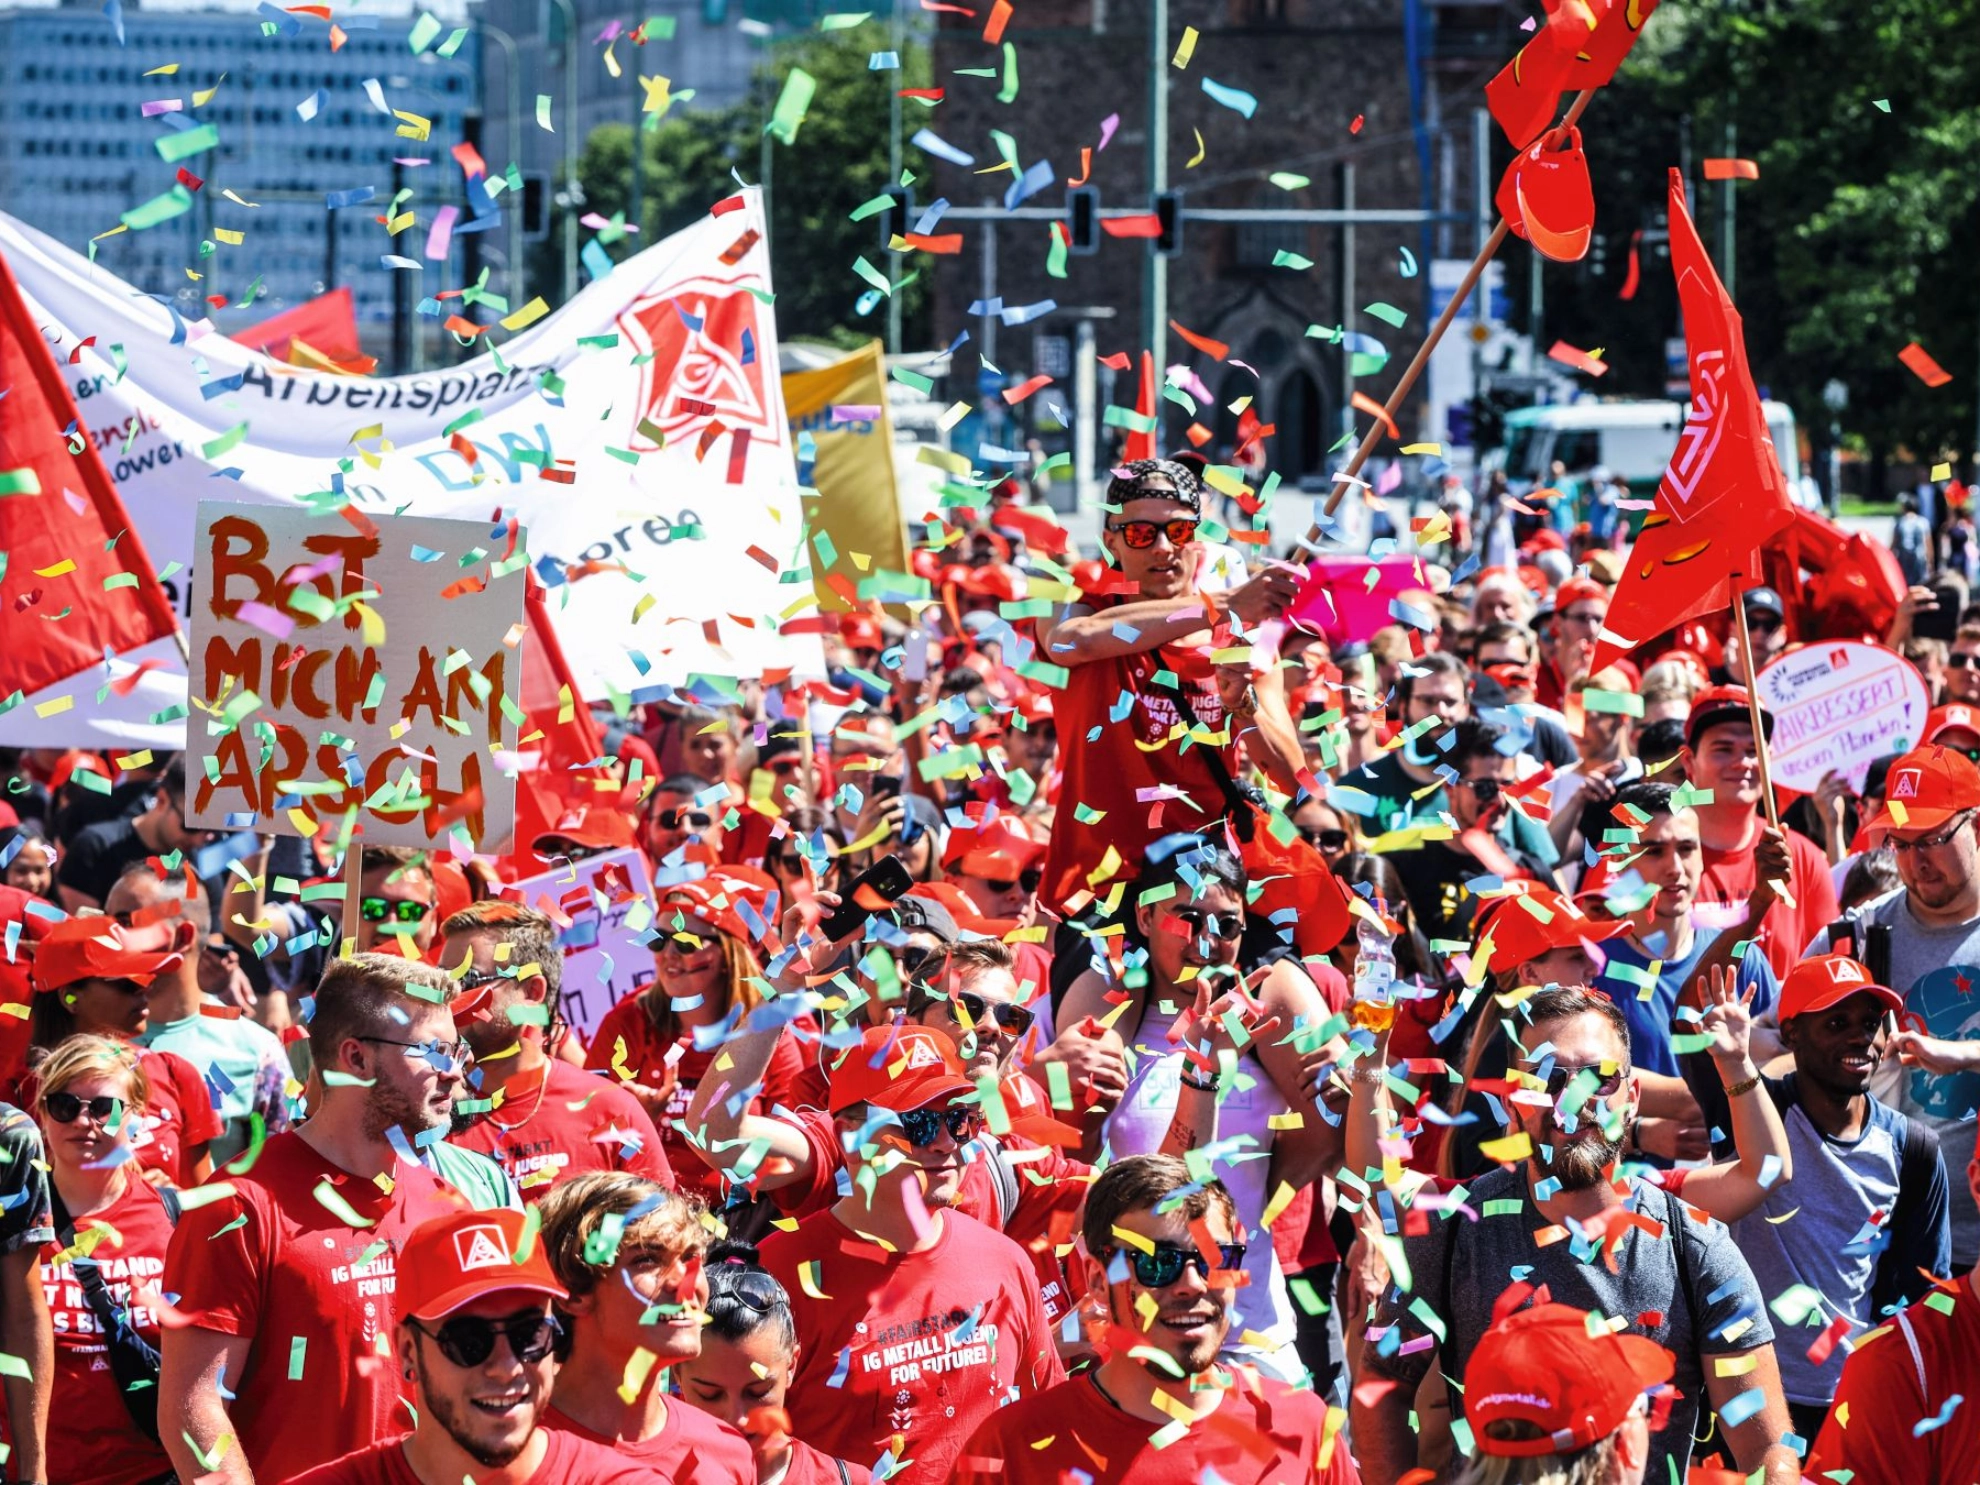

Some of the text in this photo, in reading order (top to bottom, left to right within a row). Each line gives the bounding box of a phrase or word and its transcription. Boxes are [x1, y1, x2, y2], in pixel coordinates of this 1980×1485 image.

[331, 1265, 350, 1285] IG
[358, 1278, 382, 1298] FOR
[862, 1352, 883, 1373] IG
[883, 1331, 943, 1367] METALL
[889, 1344, 988, 1386] FOR FUTURE!
